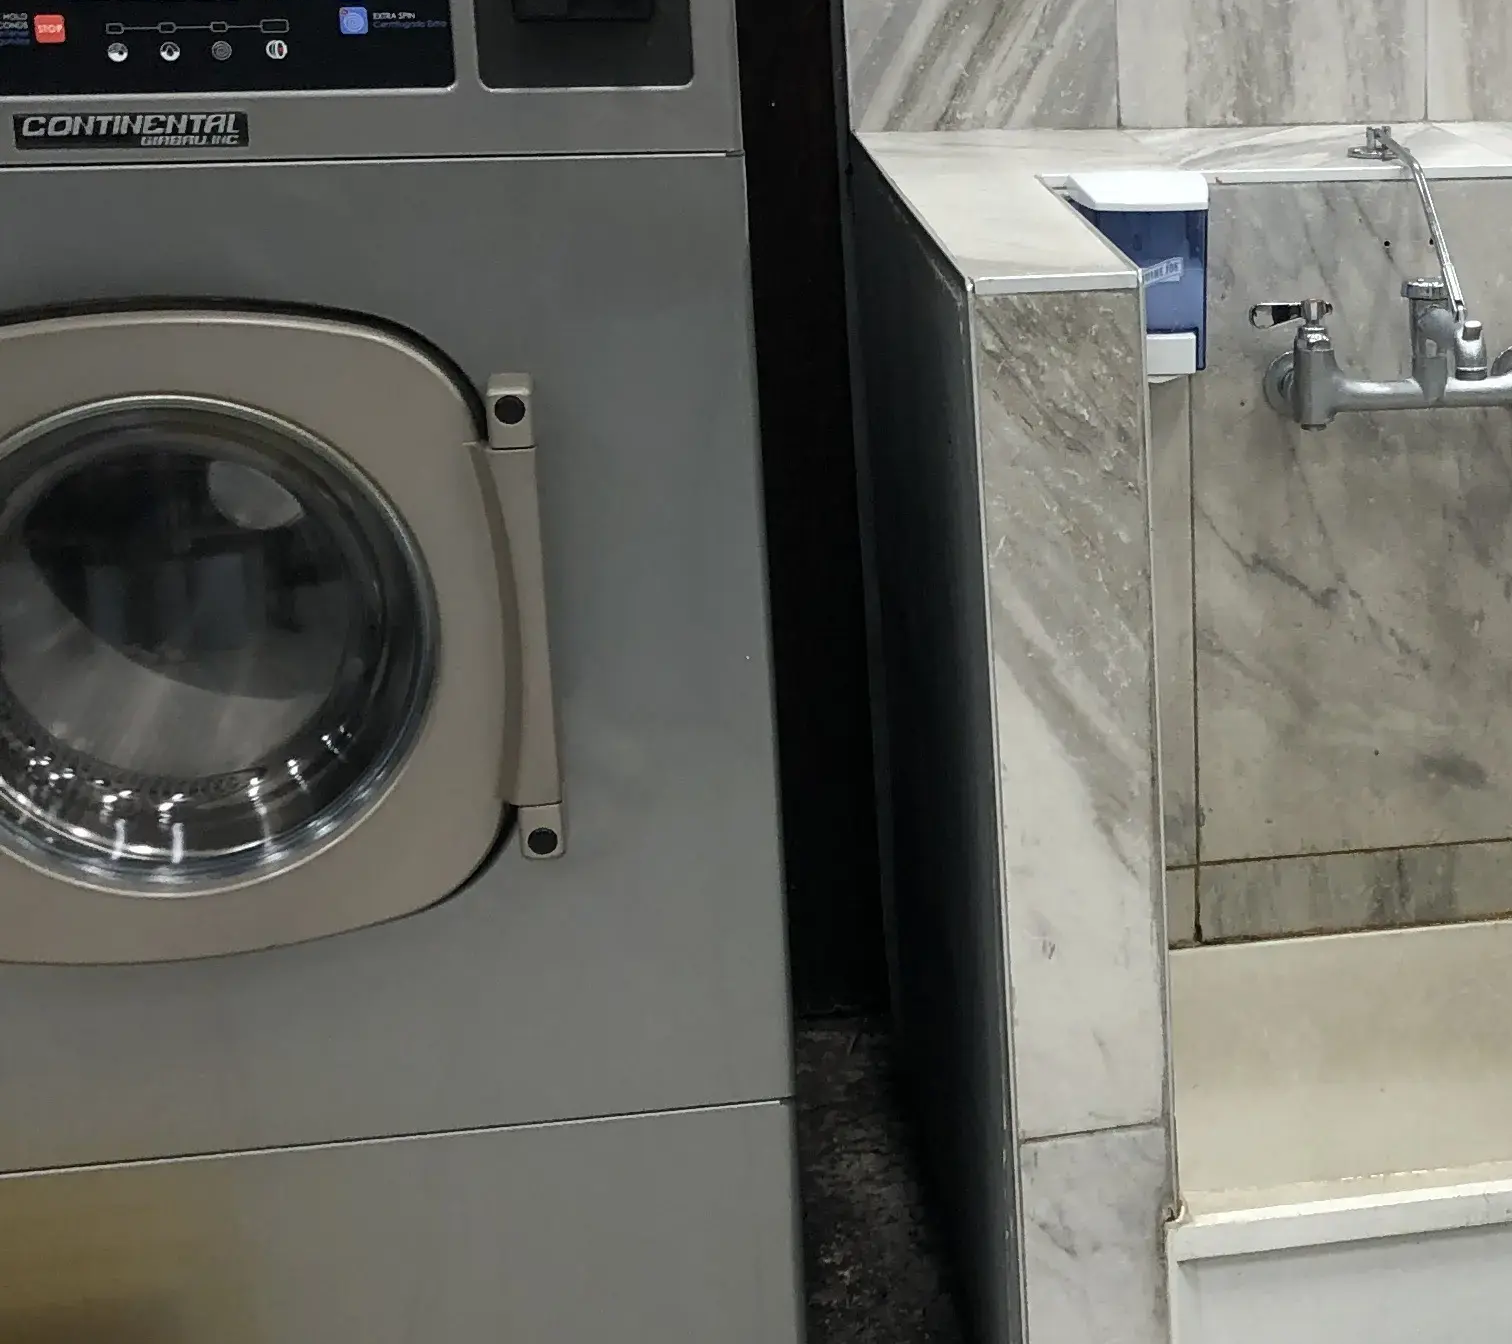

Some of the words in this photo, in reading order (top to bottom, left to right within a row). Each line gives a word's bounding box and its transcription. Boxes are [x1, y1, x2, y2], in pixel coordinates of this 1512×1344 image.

[372, 12, 397, 20] EXTRA
[37, 23, 63, 33] STOP
[21, 113, 241, 137] CONTINENTAL
